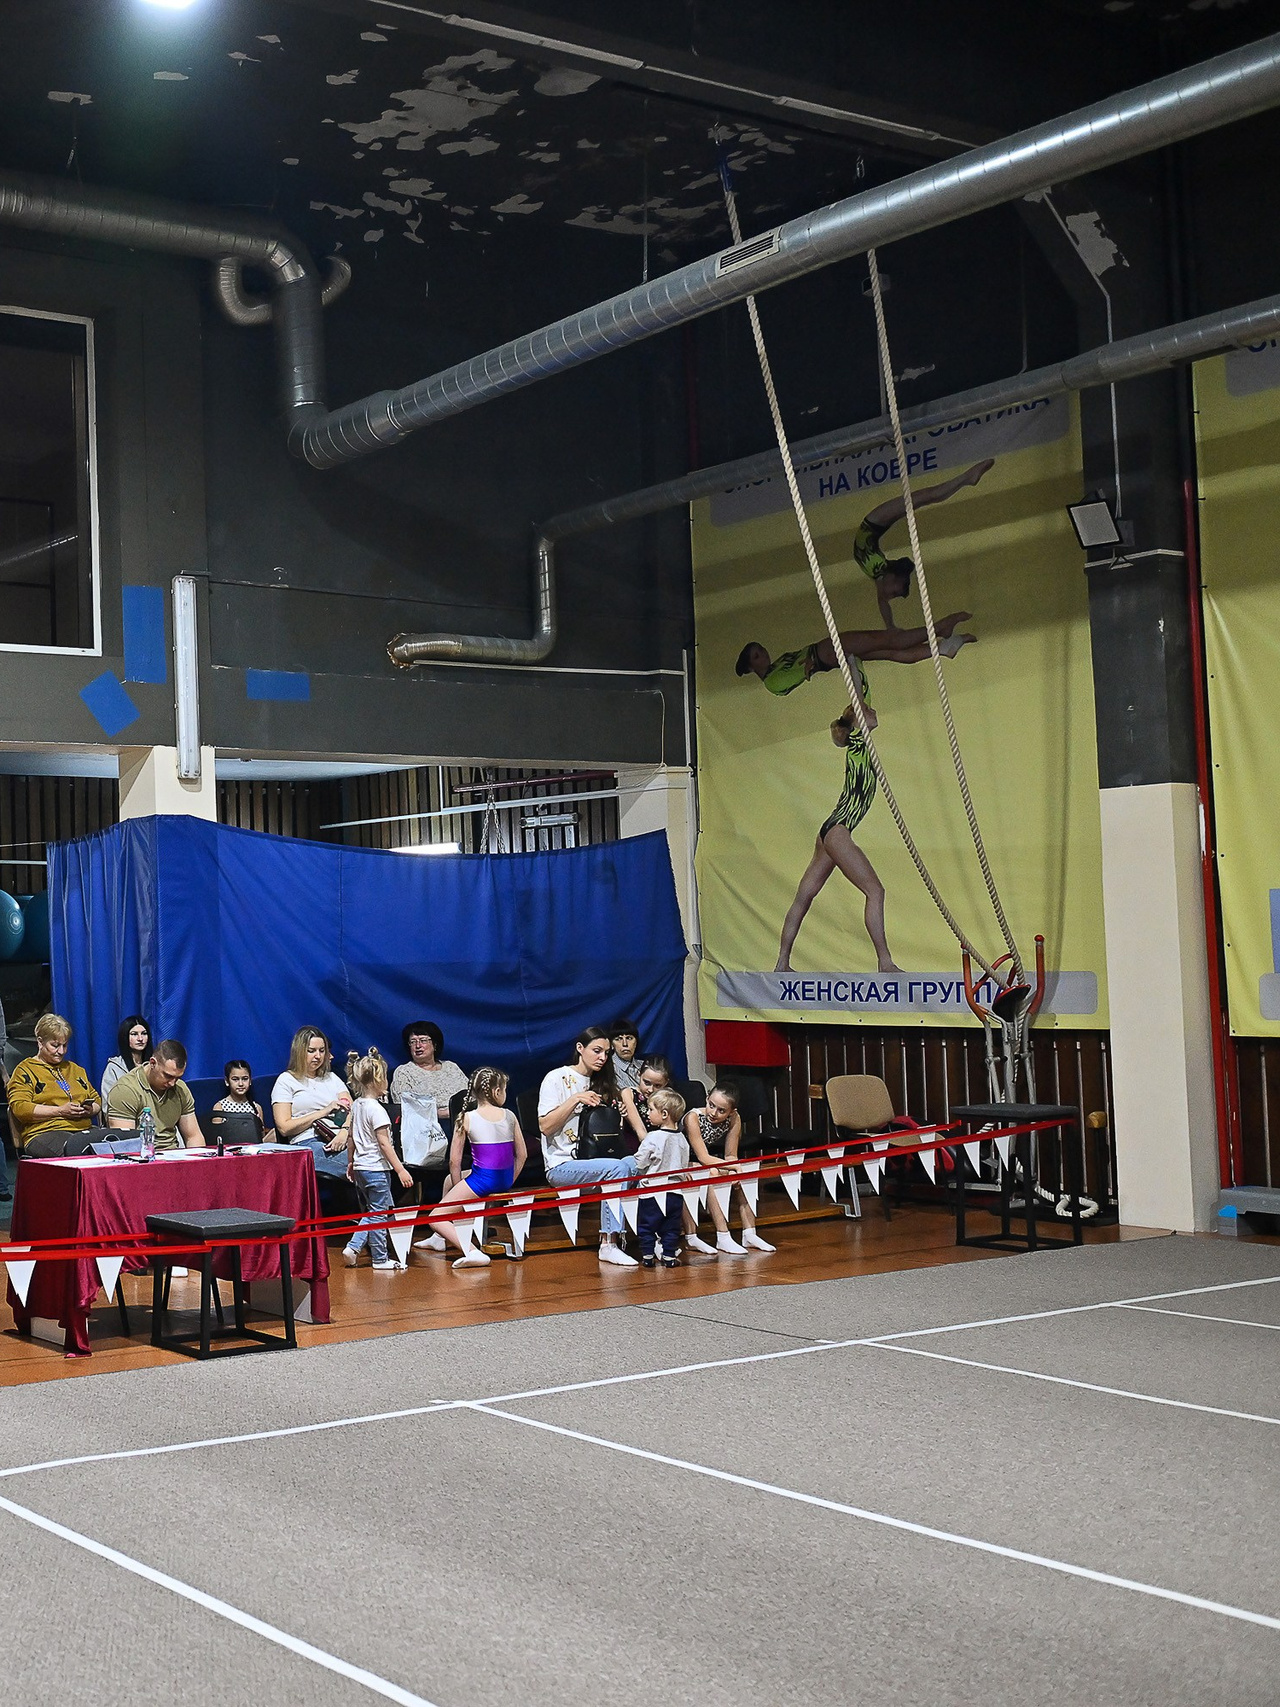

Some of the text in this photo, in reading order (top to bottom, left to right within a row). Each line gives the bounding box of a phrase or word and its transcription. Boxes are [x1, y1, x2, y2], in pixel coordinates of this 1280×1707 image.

[818, 472, 851, 497] НА
[779, 980, 1004, 1004] ЖЕНСКАЯ ГРУПП
